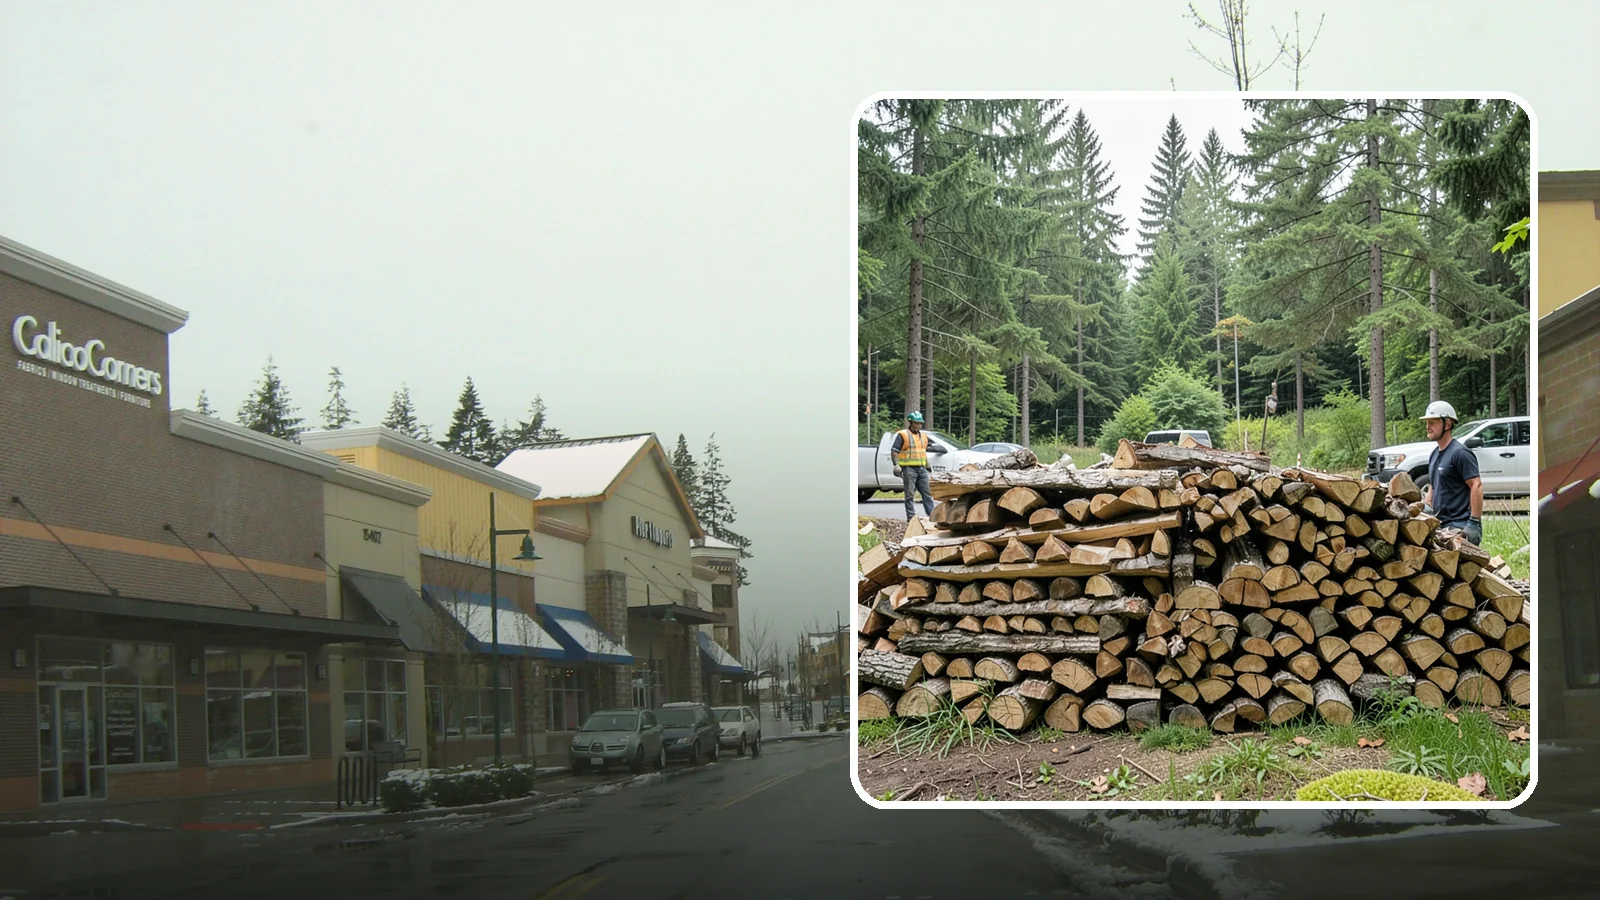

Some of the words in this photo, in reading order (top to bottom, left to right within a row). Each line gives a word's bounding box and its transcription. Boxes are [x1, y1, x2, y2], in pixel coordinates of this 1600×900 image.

[17, 360, 47, 377] FABRICS
[51, 370, 77, 386] WINDOW
[78, 379, 116, 398] TREATMENTS
[120, 391, 151, 408] FURNITURE
